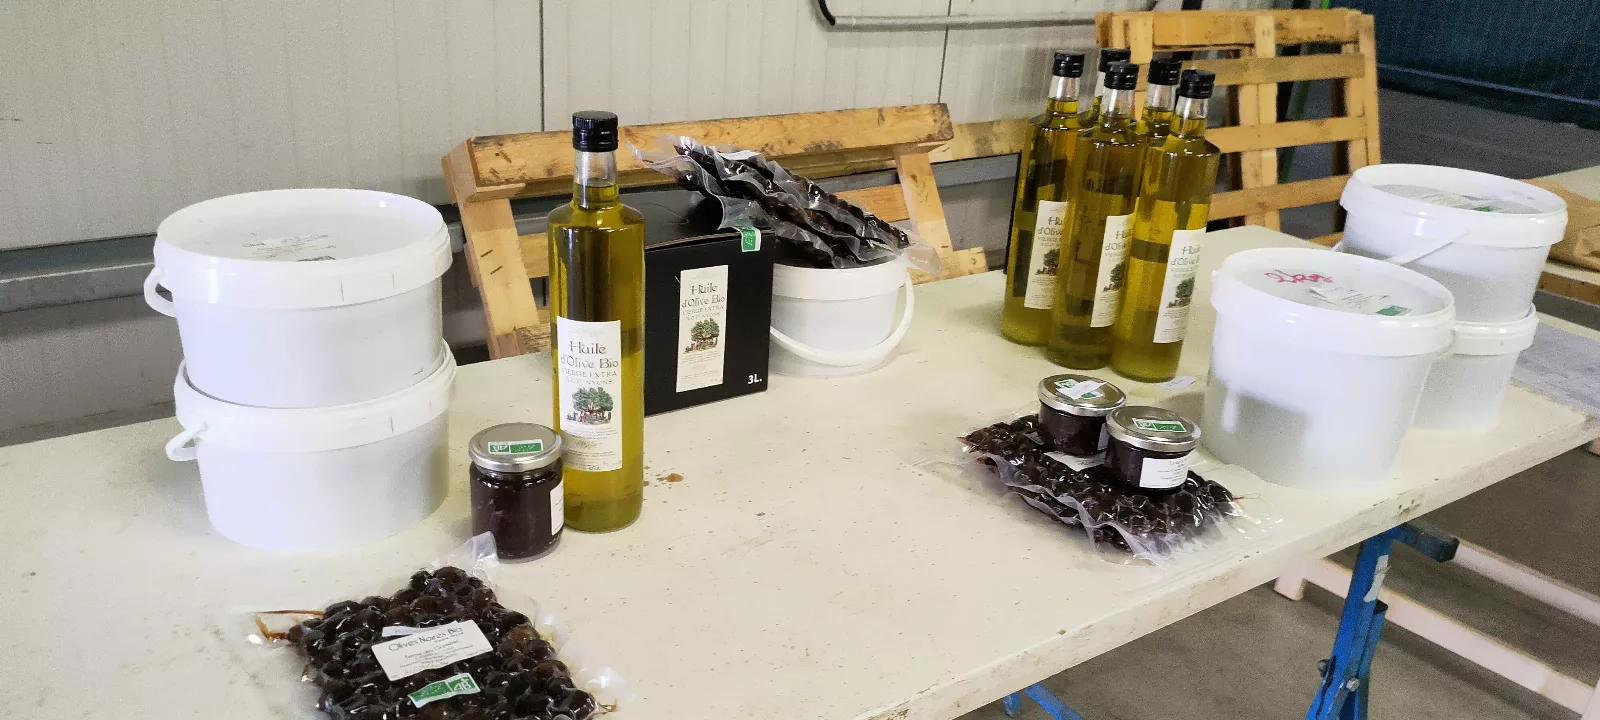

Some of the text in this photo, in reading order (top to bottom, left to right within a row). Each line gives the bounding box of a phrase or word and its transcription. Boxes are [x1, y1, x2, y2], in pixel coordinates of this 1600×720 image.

[690, 282, 718, 295] Huile
[682, 294, 726, 308] d'Olive Bio
[568, 340, 608, 355] Huile
[560, 354, 619, 369] d'Olive Bio
[589, 370, 618, 379] EXTRA
[388, 640, 418, 652] Olives
[447, 626, 463, 634] Bio
